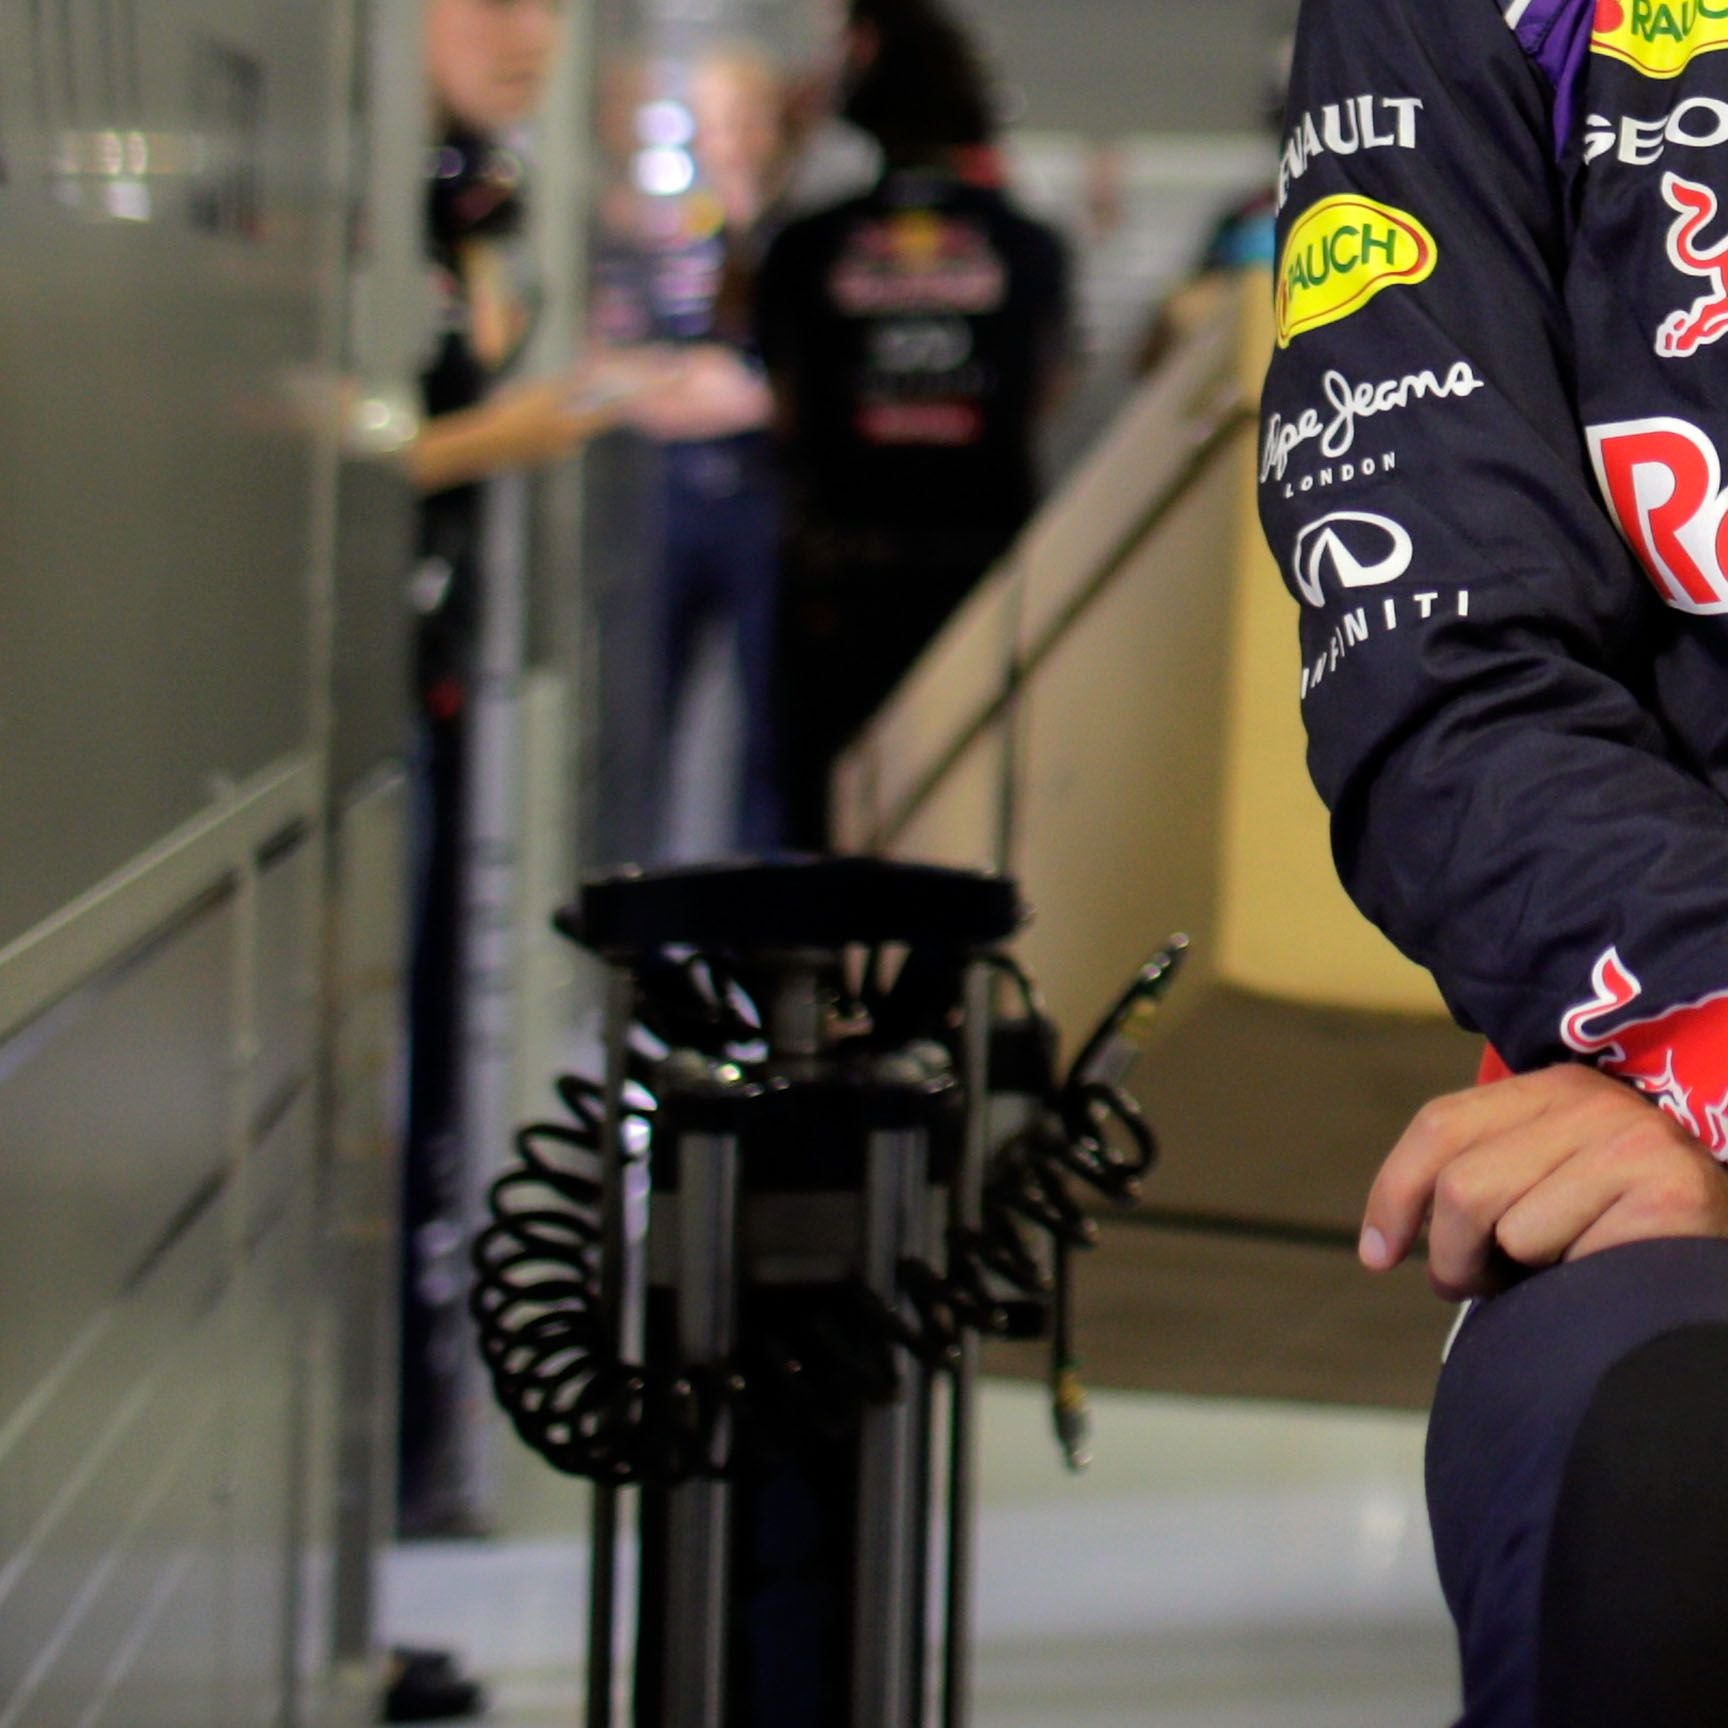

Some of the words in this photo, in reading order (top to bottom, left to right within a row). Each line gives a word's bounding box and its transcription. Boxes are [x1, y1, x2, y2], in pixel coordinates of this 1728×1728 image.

[1288, 223, 1397, 300] AUCH
[1321, 361, 1485, 458] Jeans
[1283, 450, 1397, 499] LONDON
